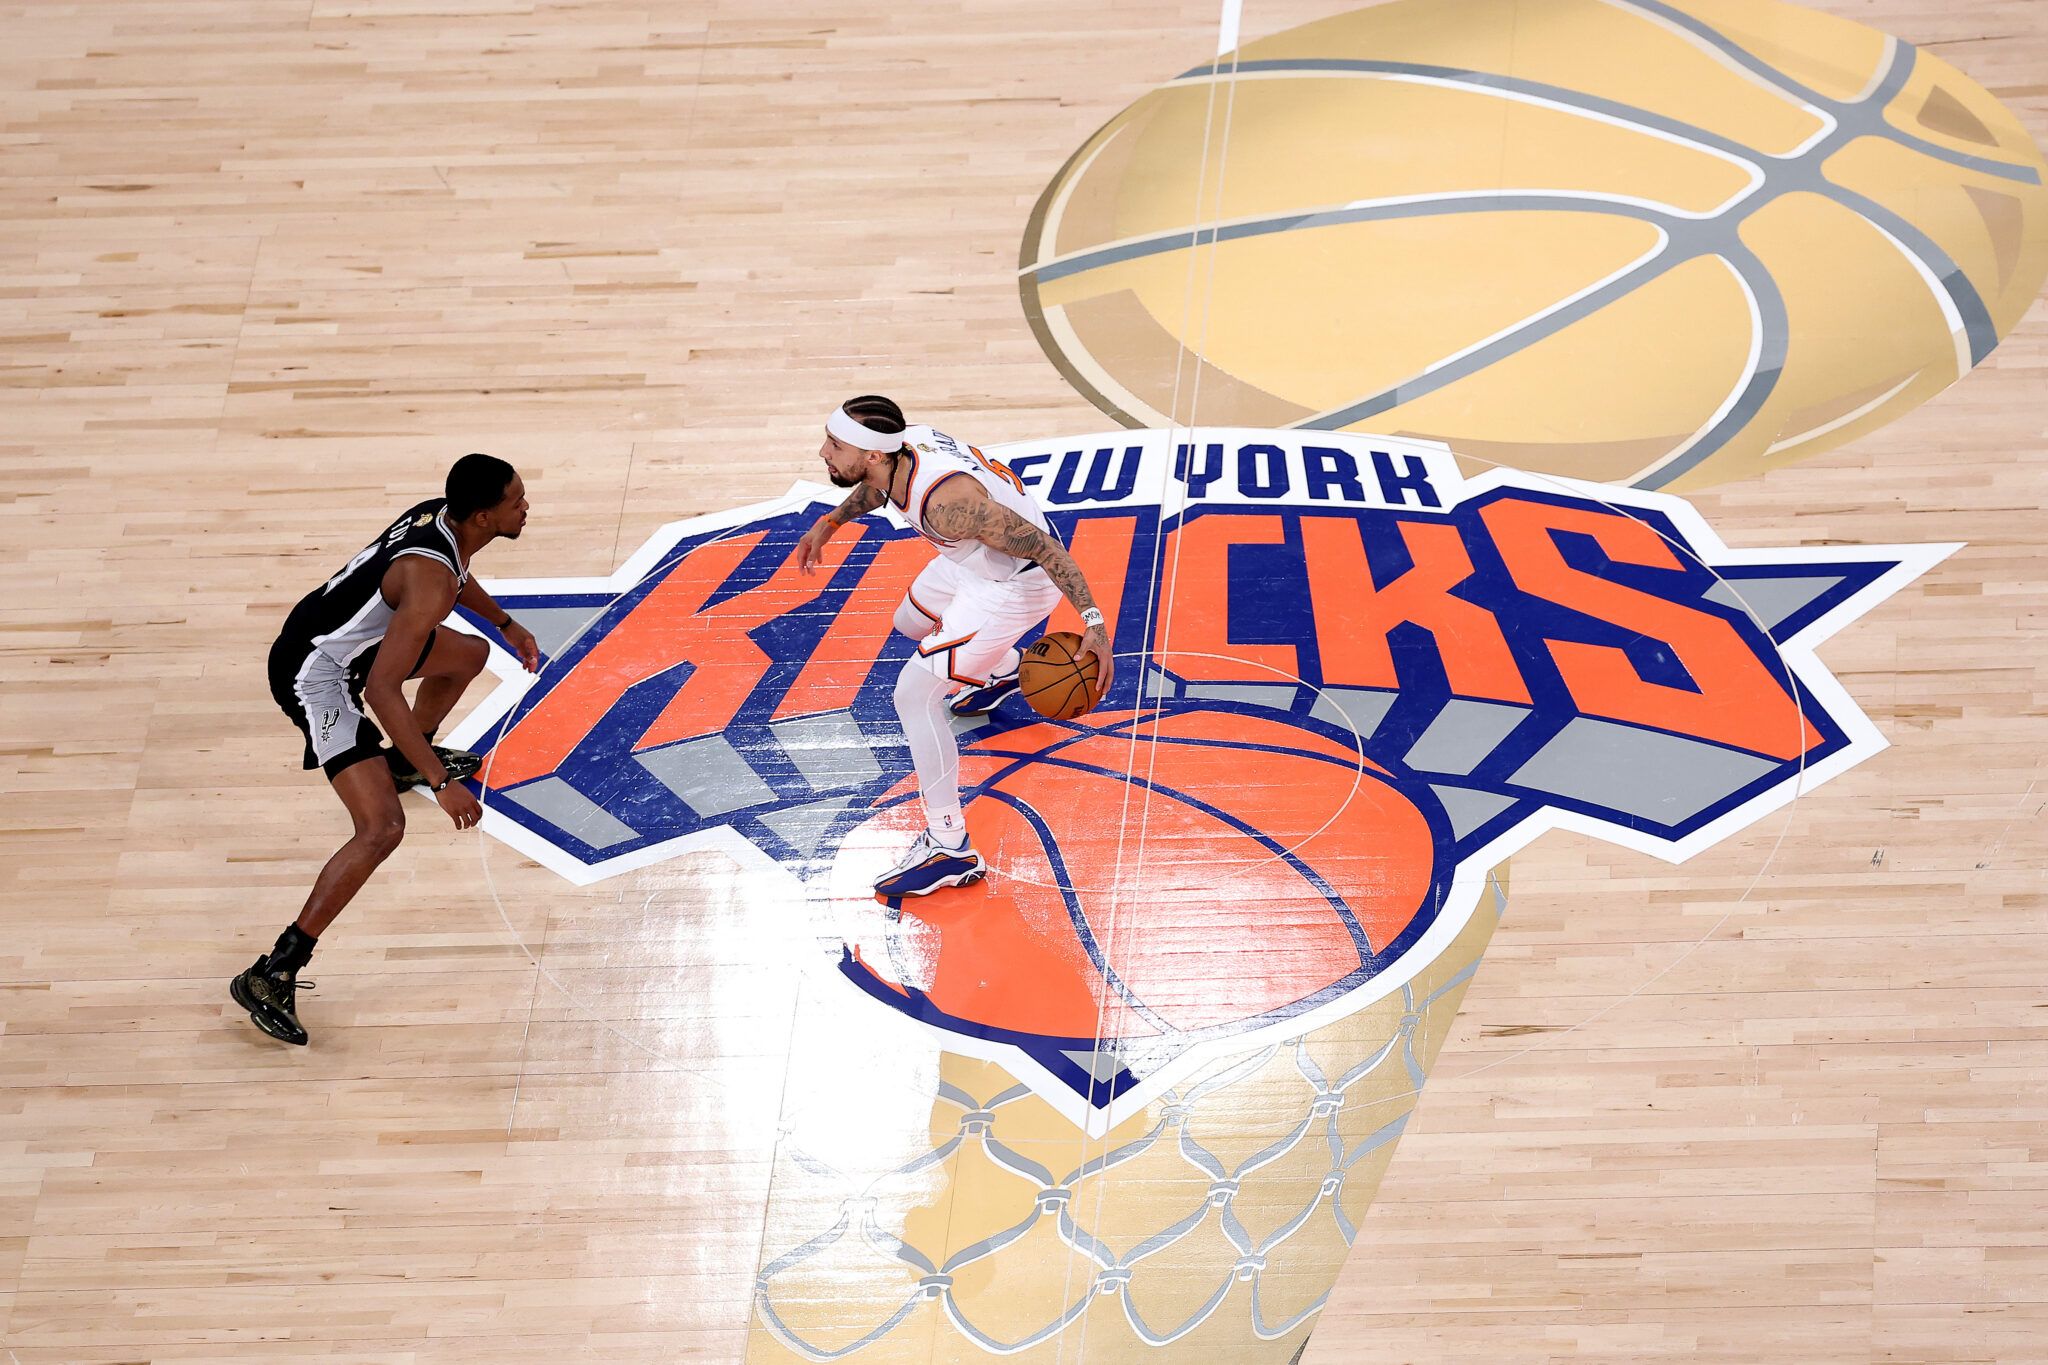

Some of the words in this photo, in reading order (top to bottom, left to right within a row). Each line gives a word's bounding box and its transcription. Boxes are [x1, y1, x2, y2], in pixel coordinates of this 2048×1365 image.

[1007, 445, 1143, 506] EW
[1173, 443, 1443, 508] YORK
[386, 516, 412, 549] FOX
